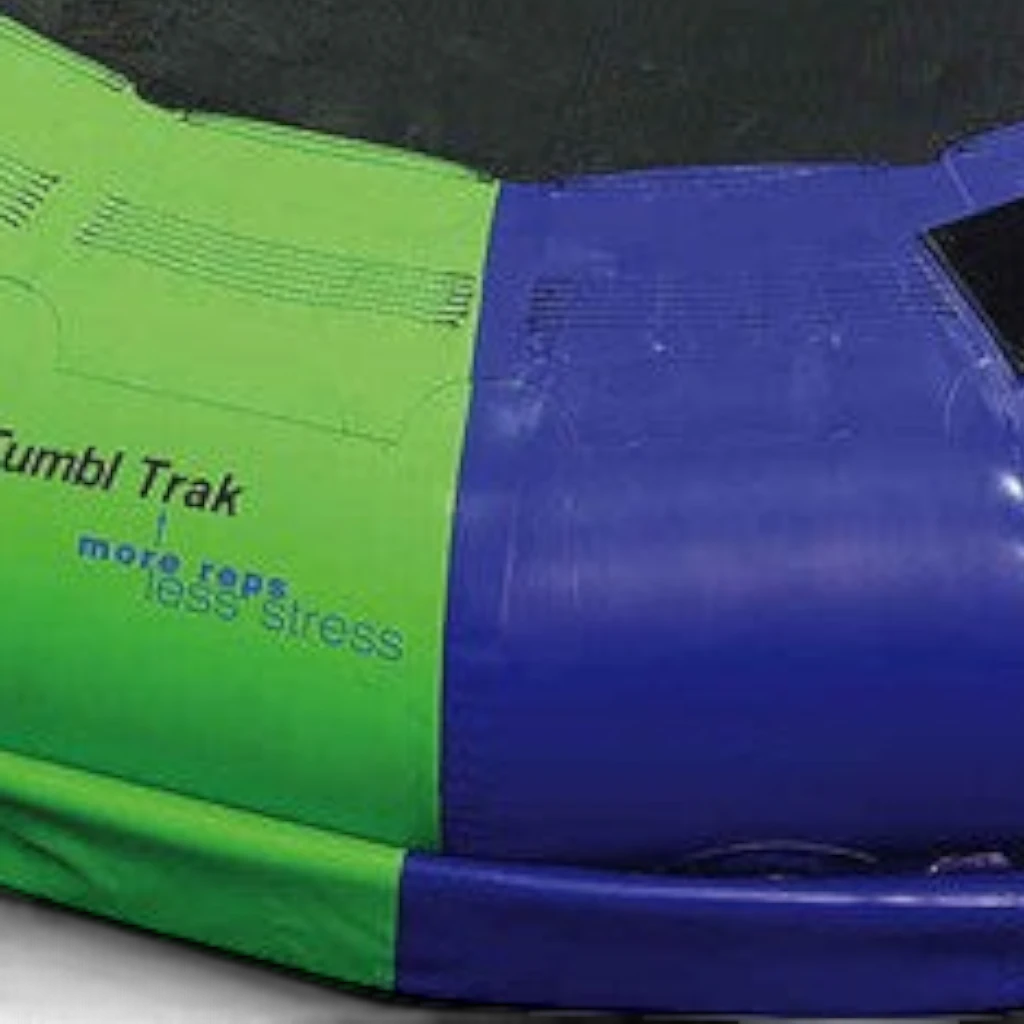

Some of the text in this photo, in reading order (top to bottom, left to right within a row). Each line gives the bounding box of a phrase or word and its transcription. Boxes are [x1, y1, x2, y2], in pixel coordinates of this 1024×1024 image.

[0, 429, 243, 516] umbl Trak
[78, 535, 287, 599] more reps
[145, 572, 402, 661] less stress
